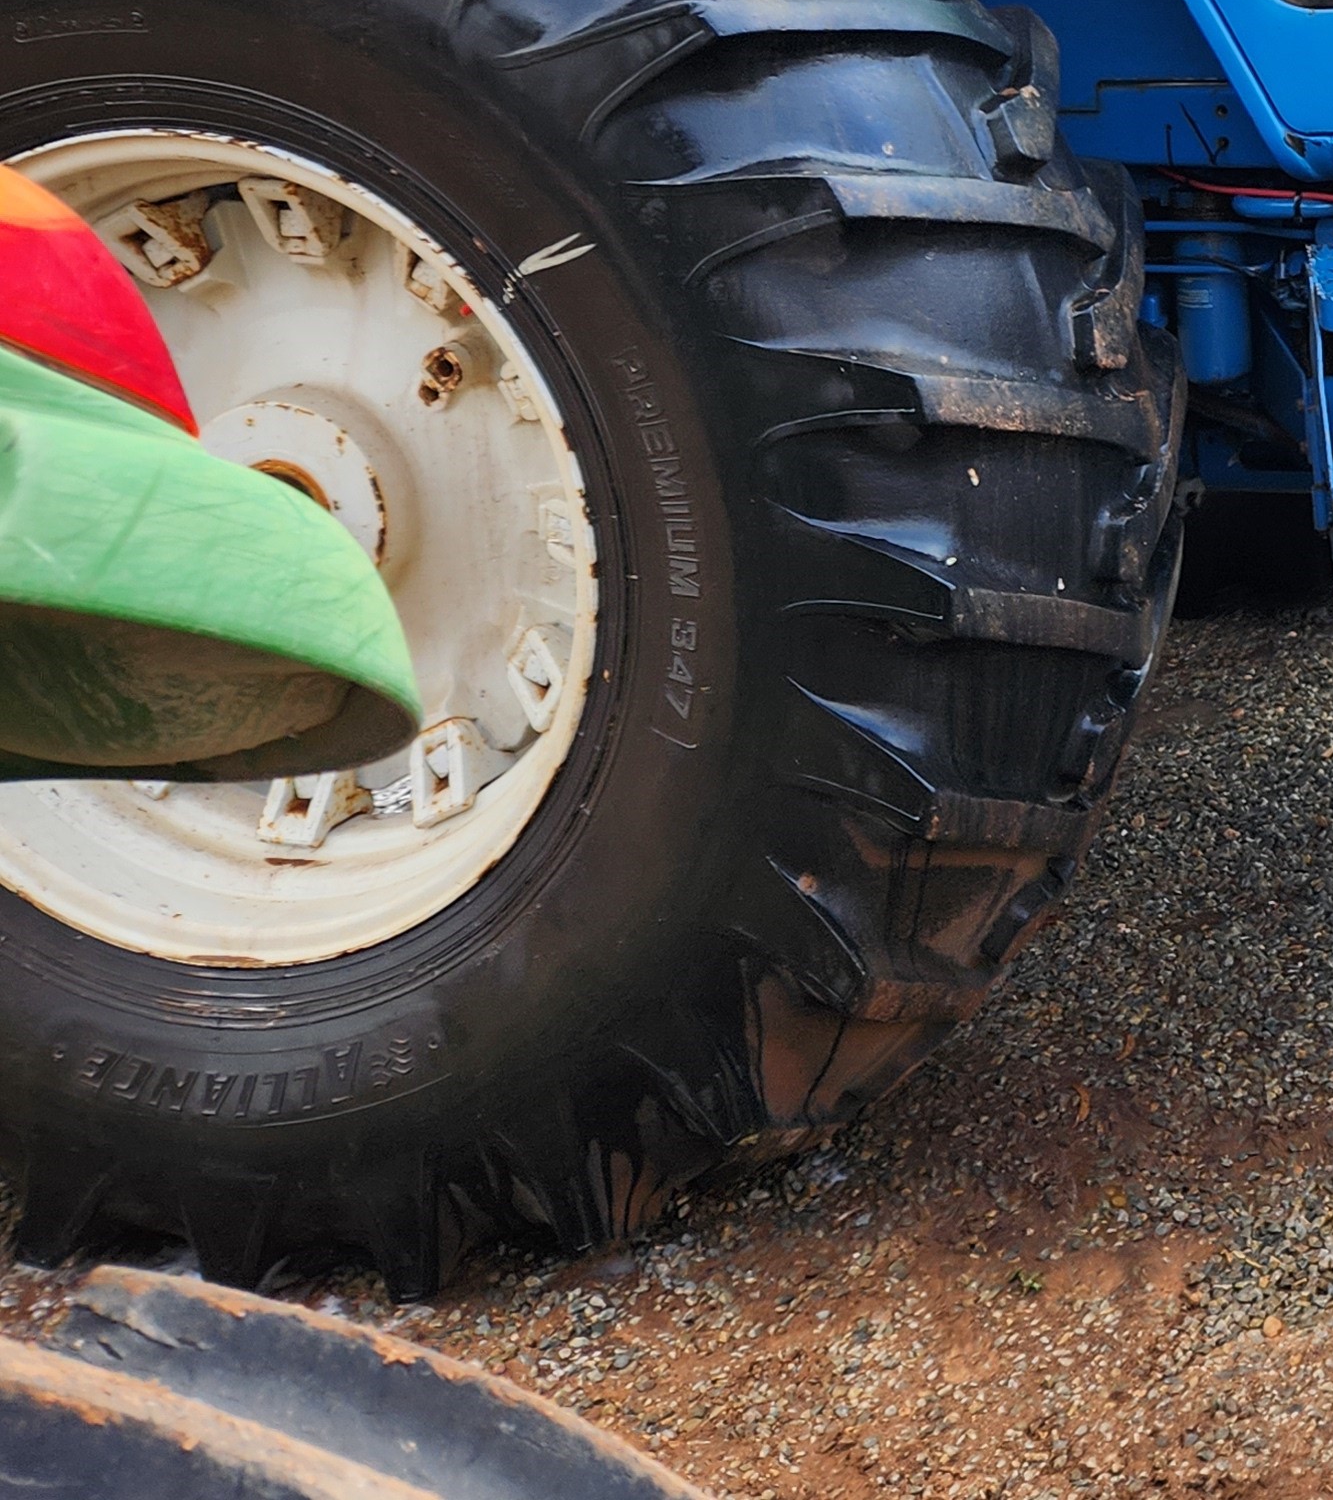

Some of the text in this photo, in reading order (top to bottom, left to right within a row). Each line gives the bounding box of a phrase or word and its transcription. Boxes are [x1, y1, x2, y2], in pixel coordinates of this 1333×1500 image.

[612, 345, 700, 721] PREMIUM 347
[80, 1040, 362, 1117] ALLIANCE
